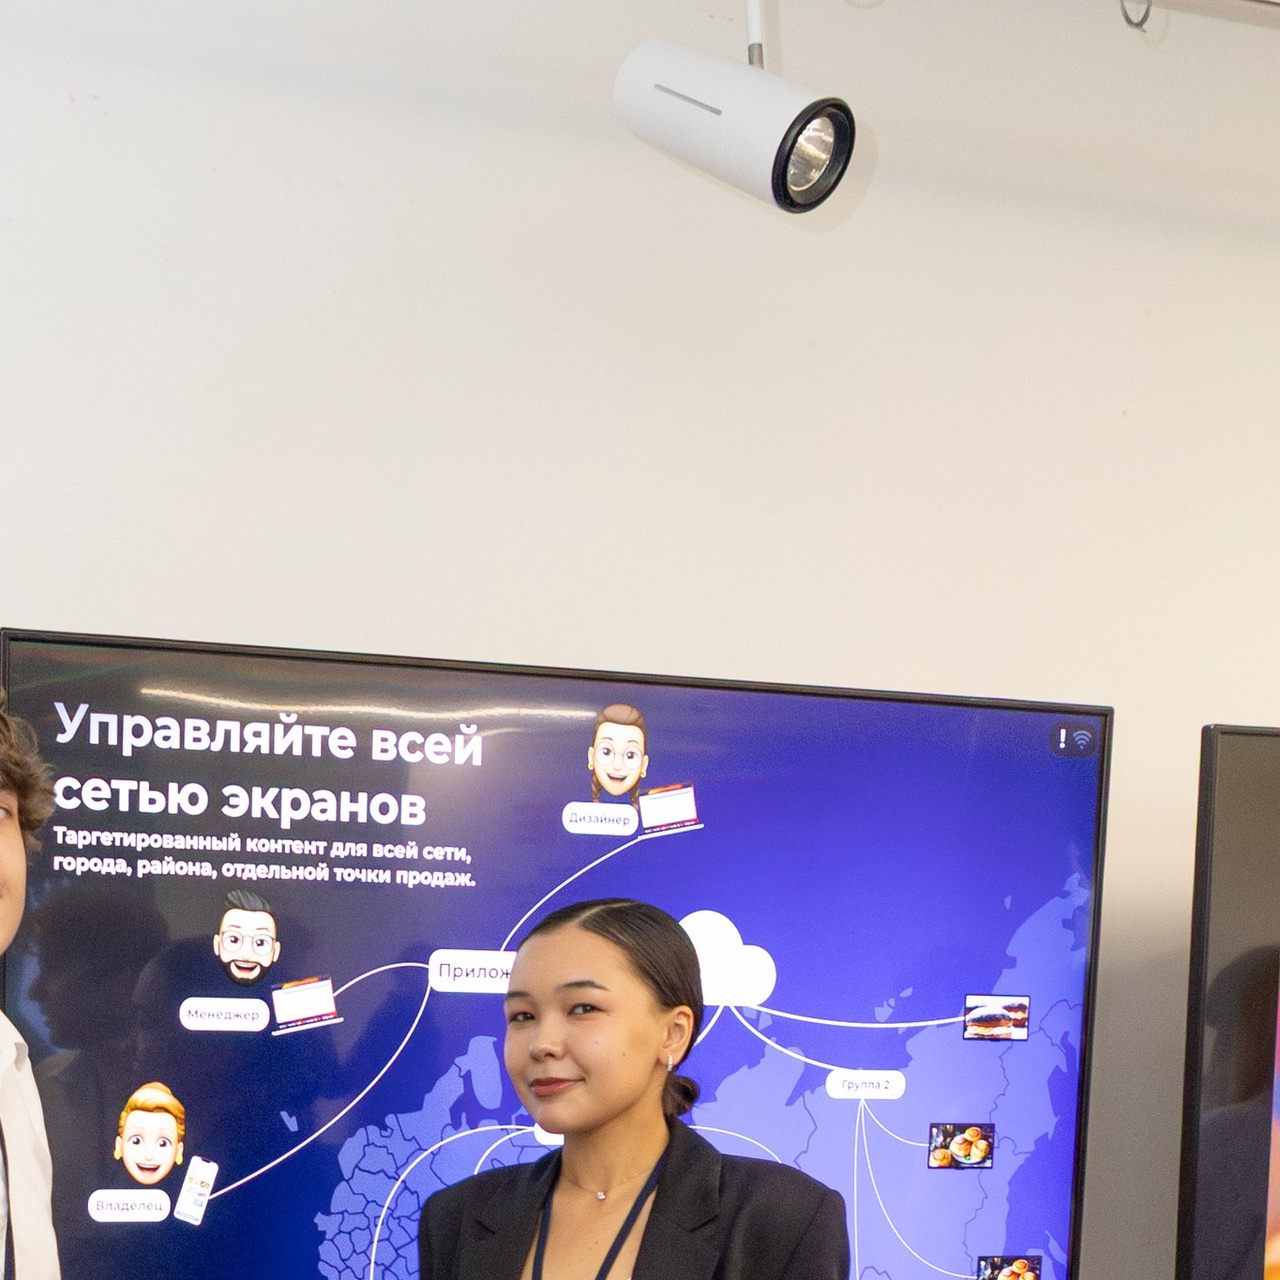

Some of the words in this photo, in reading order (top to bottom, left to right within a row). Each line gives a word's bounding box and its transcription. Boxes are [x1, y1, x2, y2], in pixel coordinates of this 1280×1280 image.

[53, 702, 357, 759] Управляйте
[371, 723, 483, 766] всей
[53, 776, 209, 816] сетью
[220, 784, 427, 830] экранов
[568, 812, 631, 827] Дизайнер
[53, 825, 241, 852] Таргетированный
[245, 837, 328, 856] контент
[330, 841, 368, 858] для
[372, 841, 419, 860] всей
[422, 845, 472, 865] сети,
[53, 855, 133, 877] города,
[136, 856, 218, 880] района,
[221, 862, 330, 881] отдельной
[333, 866, 391, 884] точки
[395, 869, 477, 889] продаж.
[187, 1009, 260, 1023] Менеджер
[842, 1079, 881, 1092] Группа
[883, 1080, 890, 1090] 2
[96, 1200, 163, 1212] Владелец
